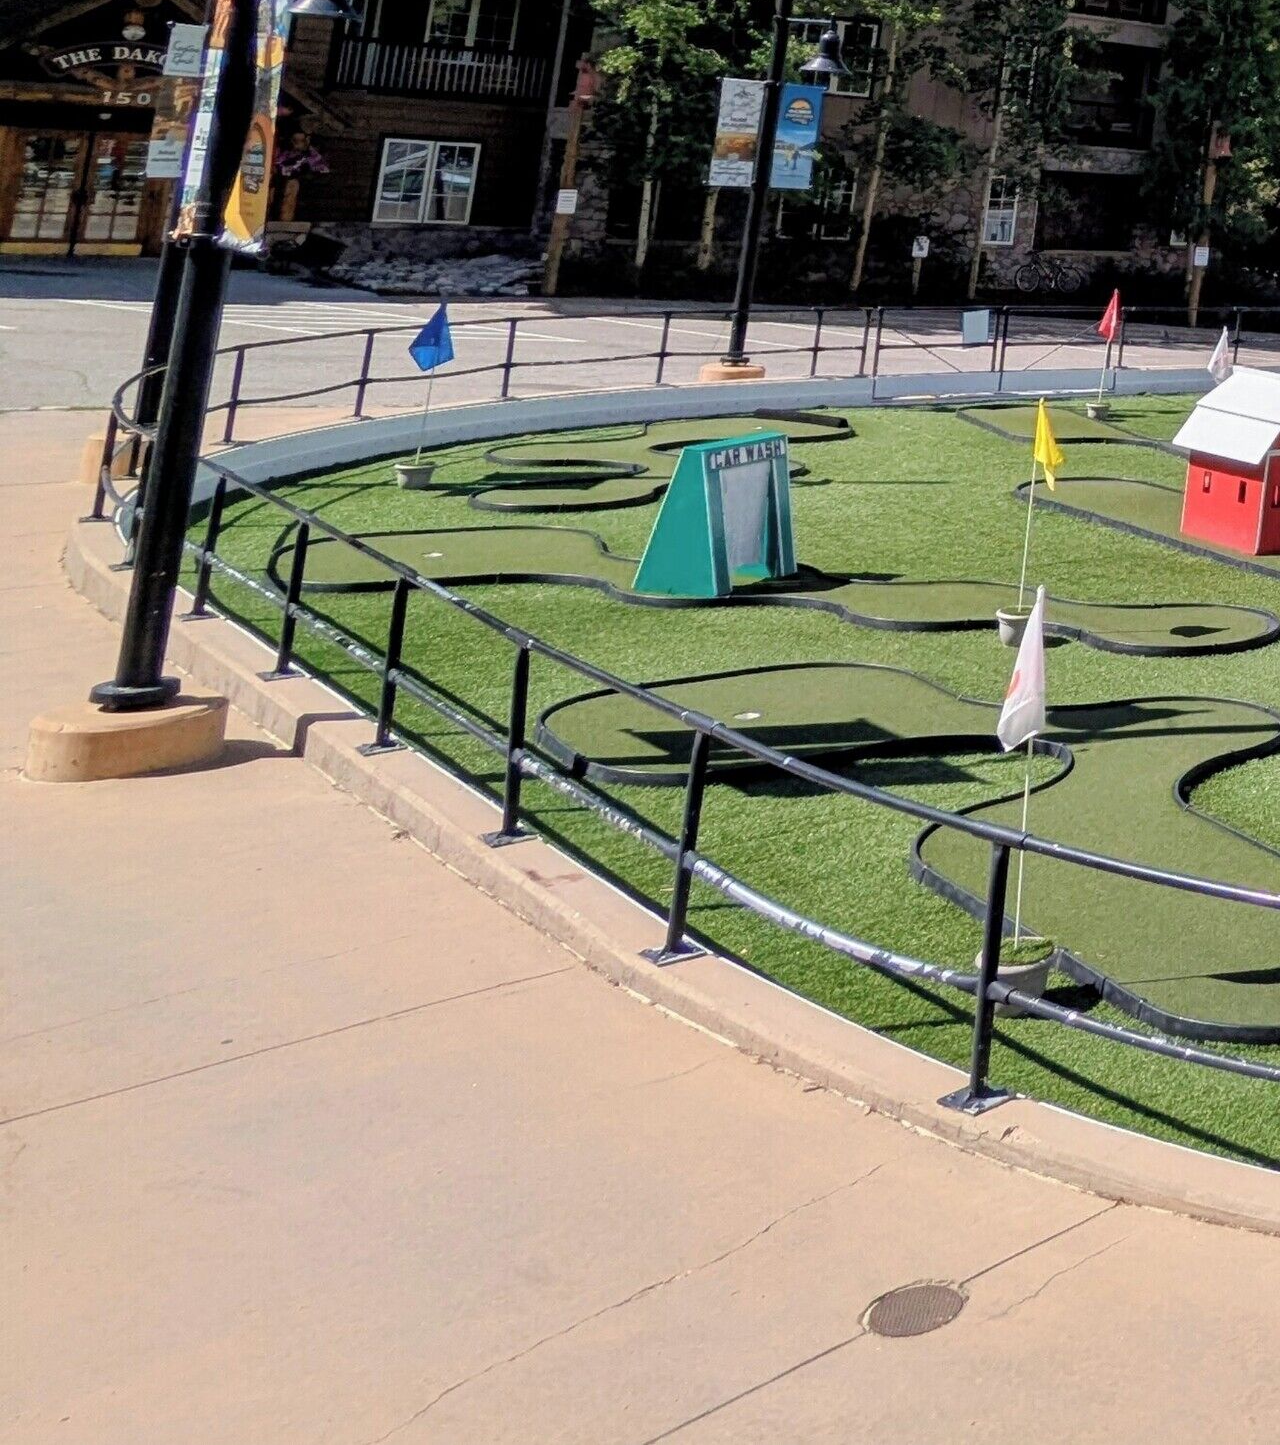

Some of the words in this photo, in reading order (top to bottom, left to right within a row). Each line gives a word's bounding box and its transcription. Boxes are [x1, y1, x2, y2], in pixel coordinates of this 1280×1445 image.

[52, 47, 103, 70] THE
[102, 90, 151, 105] 150
[714, 447, 740, 469] CAR
[745, 439, 783, 461] WASH
